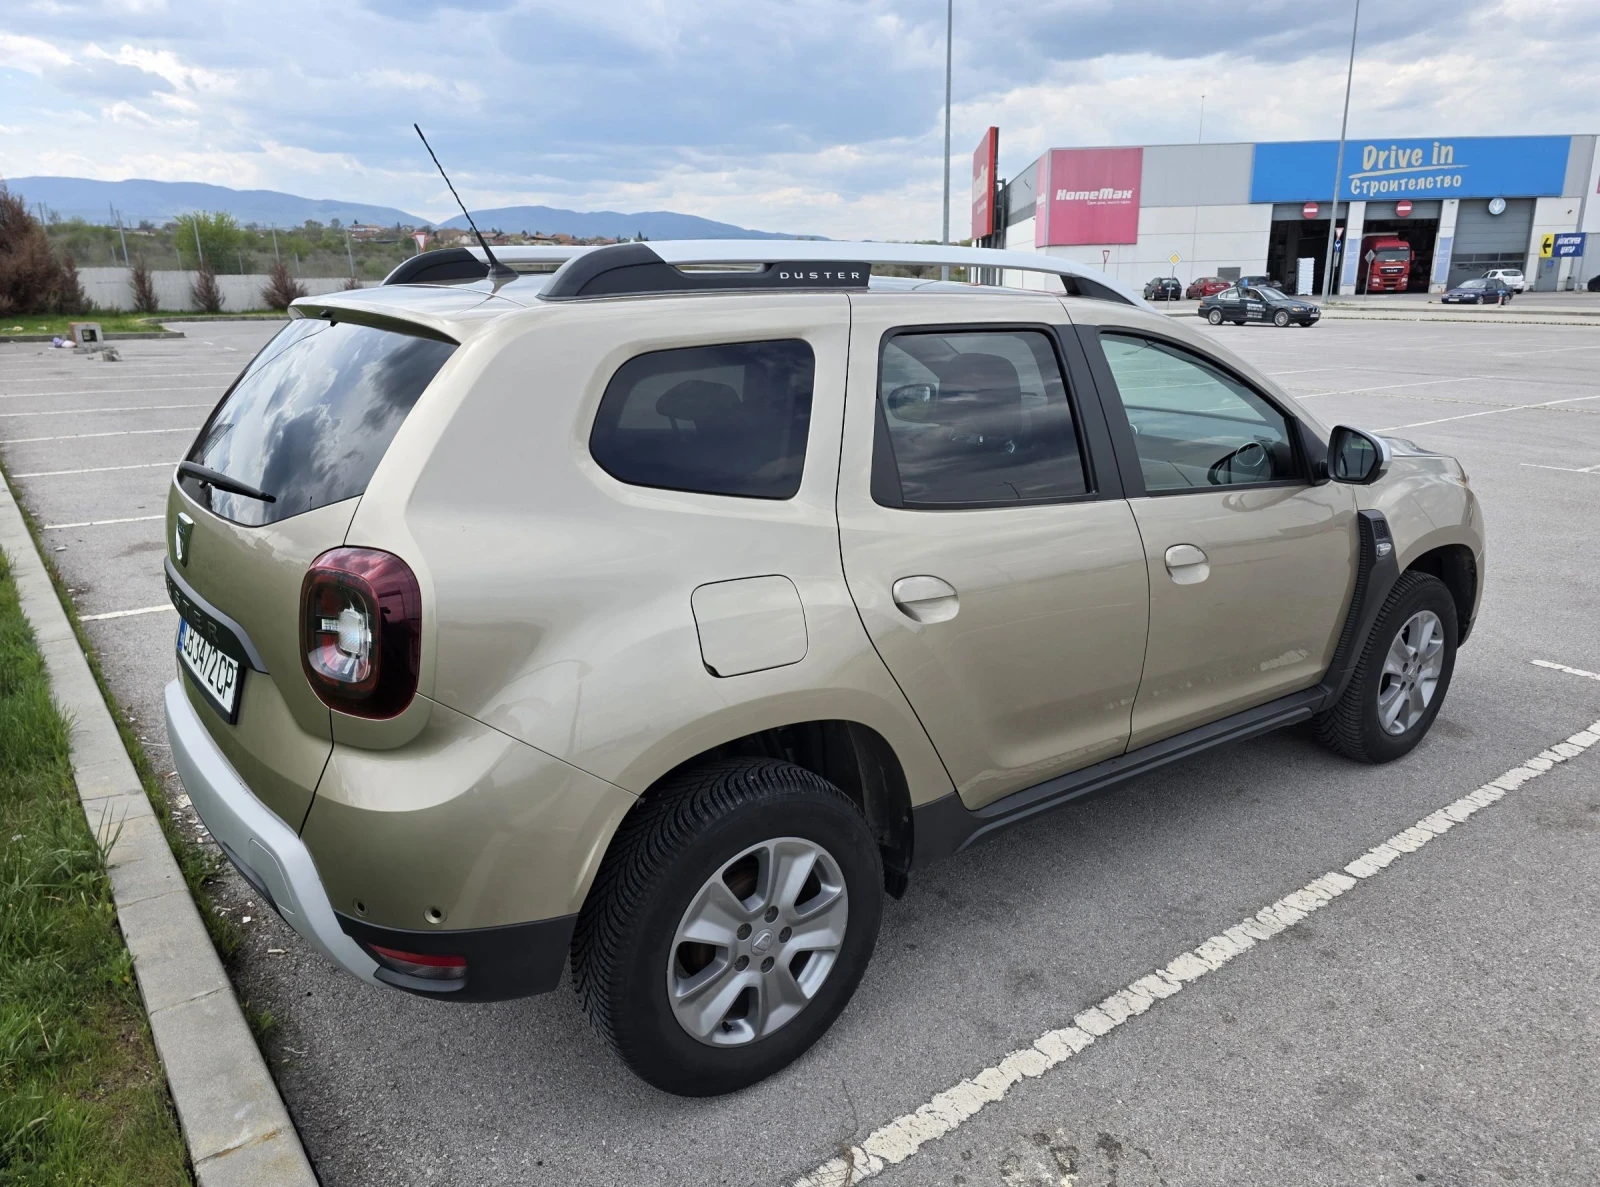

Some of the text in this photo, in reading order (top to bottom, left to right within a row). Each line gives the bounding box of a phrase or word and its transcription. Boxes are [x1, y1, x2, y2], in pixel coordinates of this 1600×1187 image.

[1362, 141, 1454, 170] Drive in
[1056, 187, 1133, 201] HomeMax
[1350, 175, 1462, 197] Строителство
[779, 271, 860, 279] DUSTER
